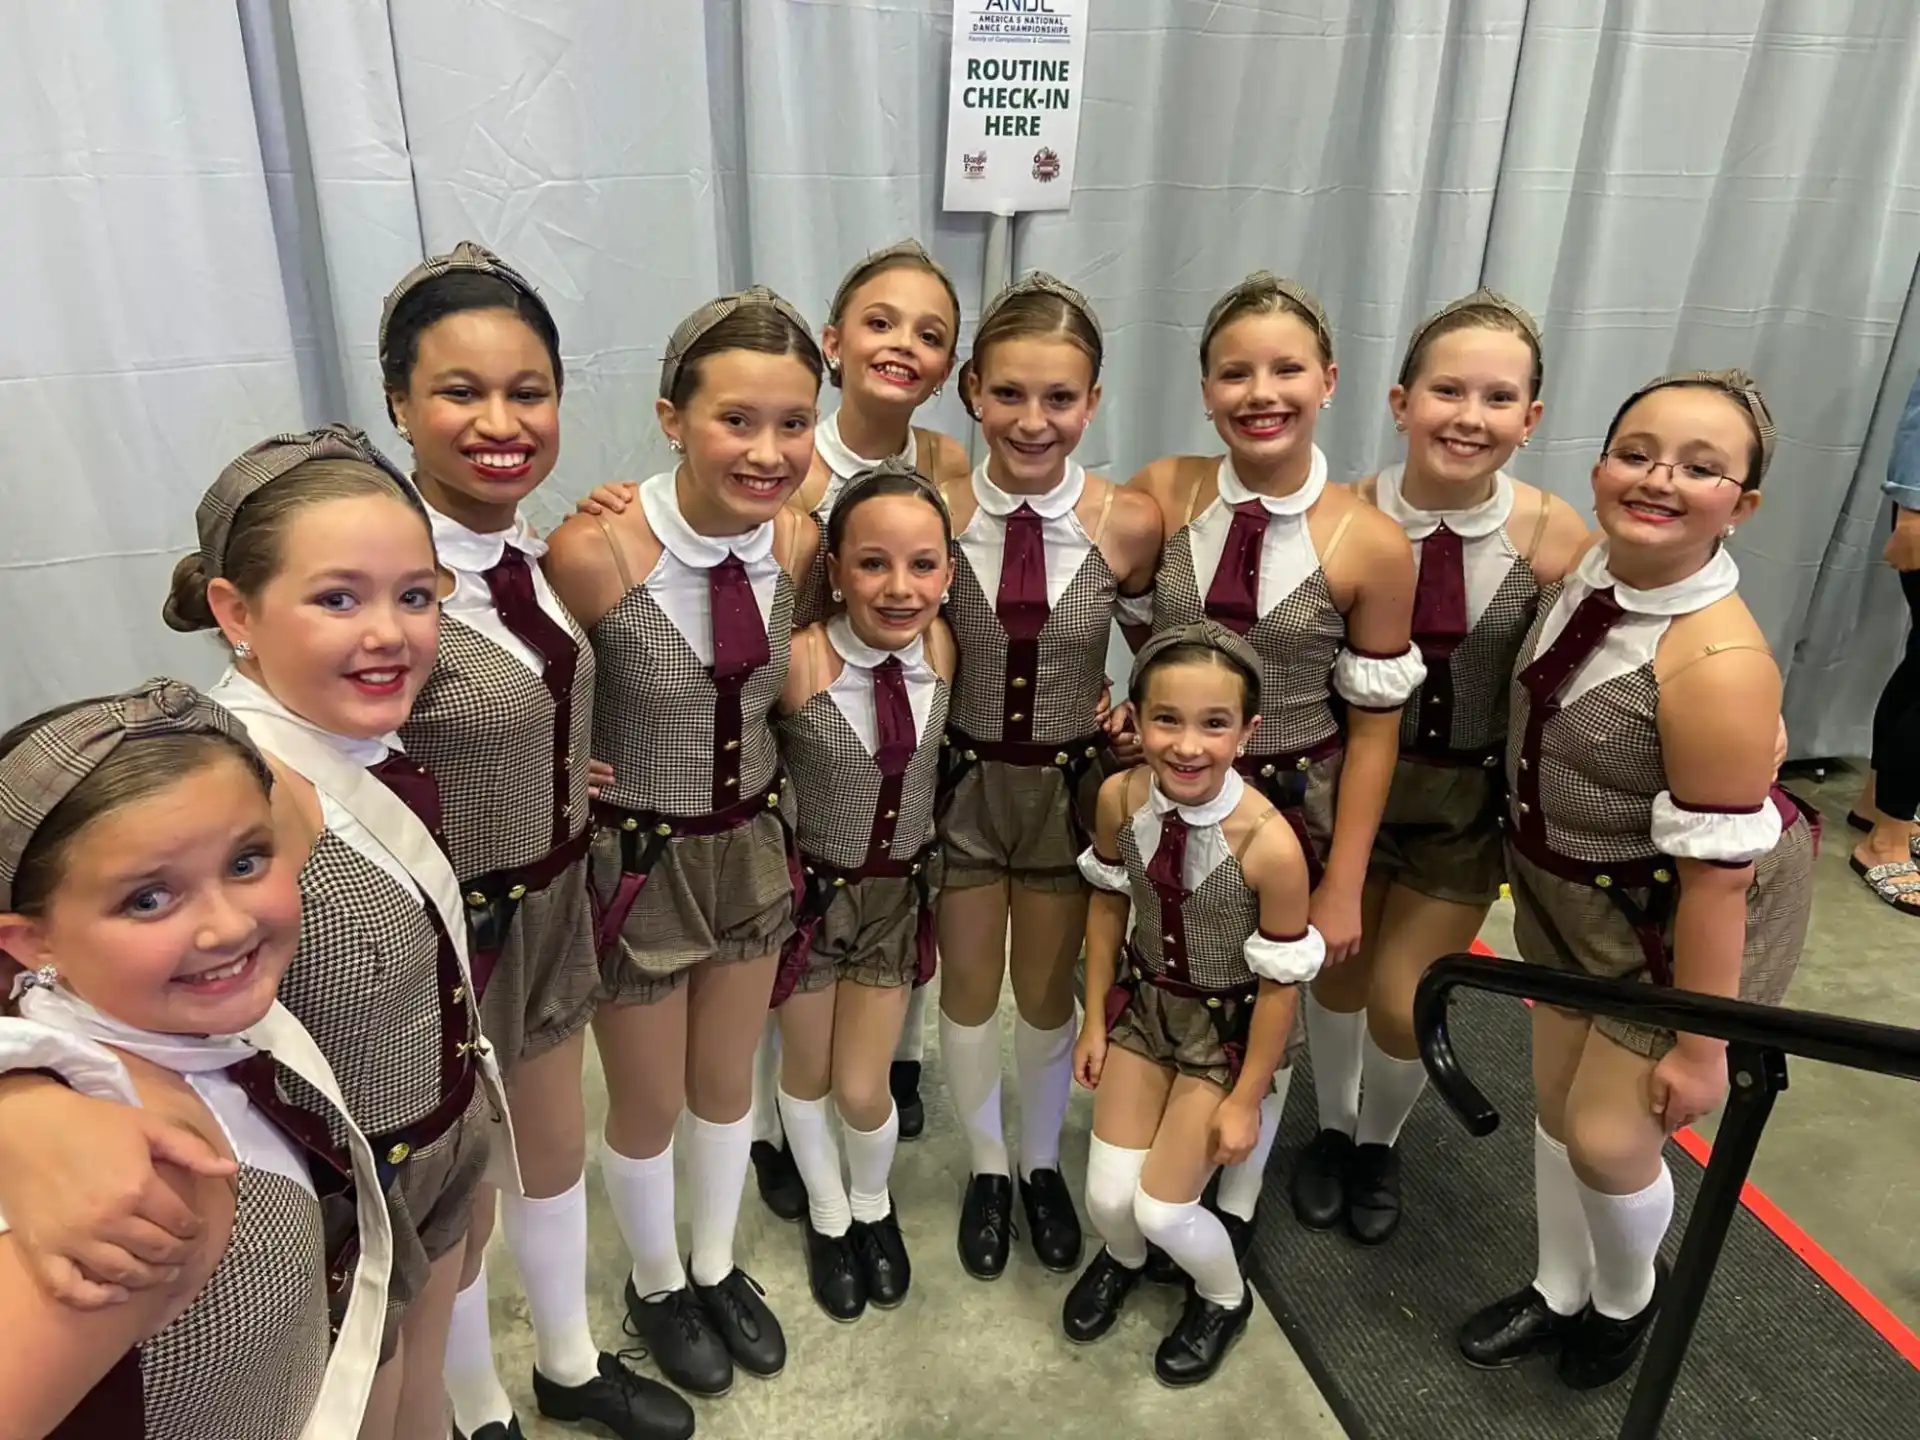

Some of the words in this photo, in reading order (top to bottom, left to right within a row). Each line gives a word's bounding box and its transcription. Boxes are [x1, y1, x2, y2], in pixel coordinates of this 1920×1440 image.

[973, 24, 1000, 32] DANCE
[1004, 25, 1068, 34] CHAMPIONSHIPS
[979, 15, 1021, 24] AMERICAS
[1024, 16, 1063, 25] NATIONAL
[967, 58, 1069, 82] ROUTINE
[963, 87, 1069, 109] CHECK-IN
[985, 115, 1041, 136] HERE
